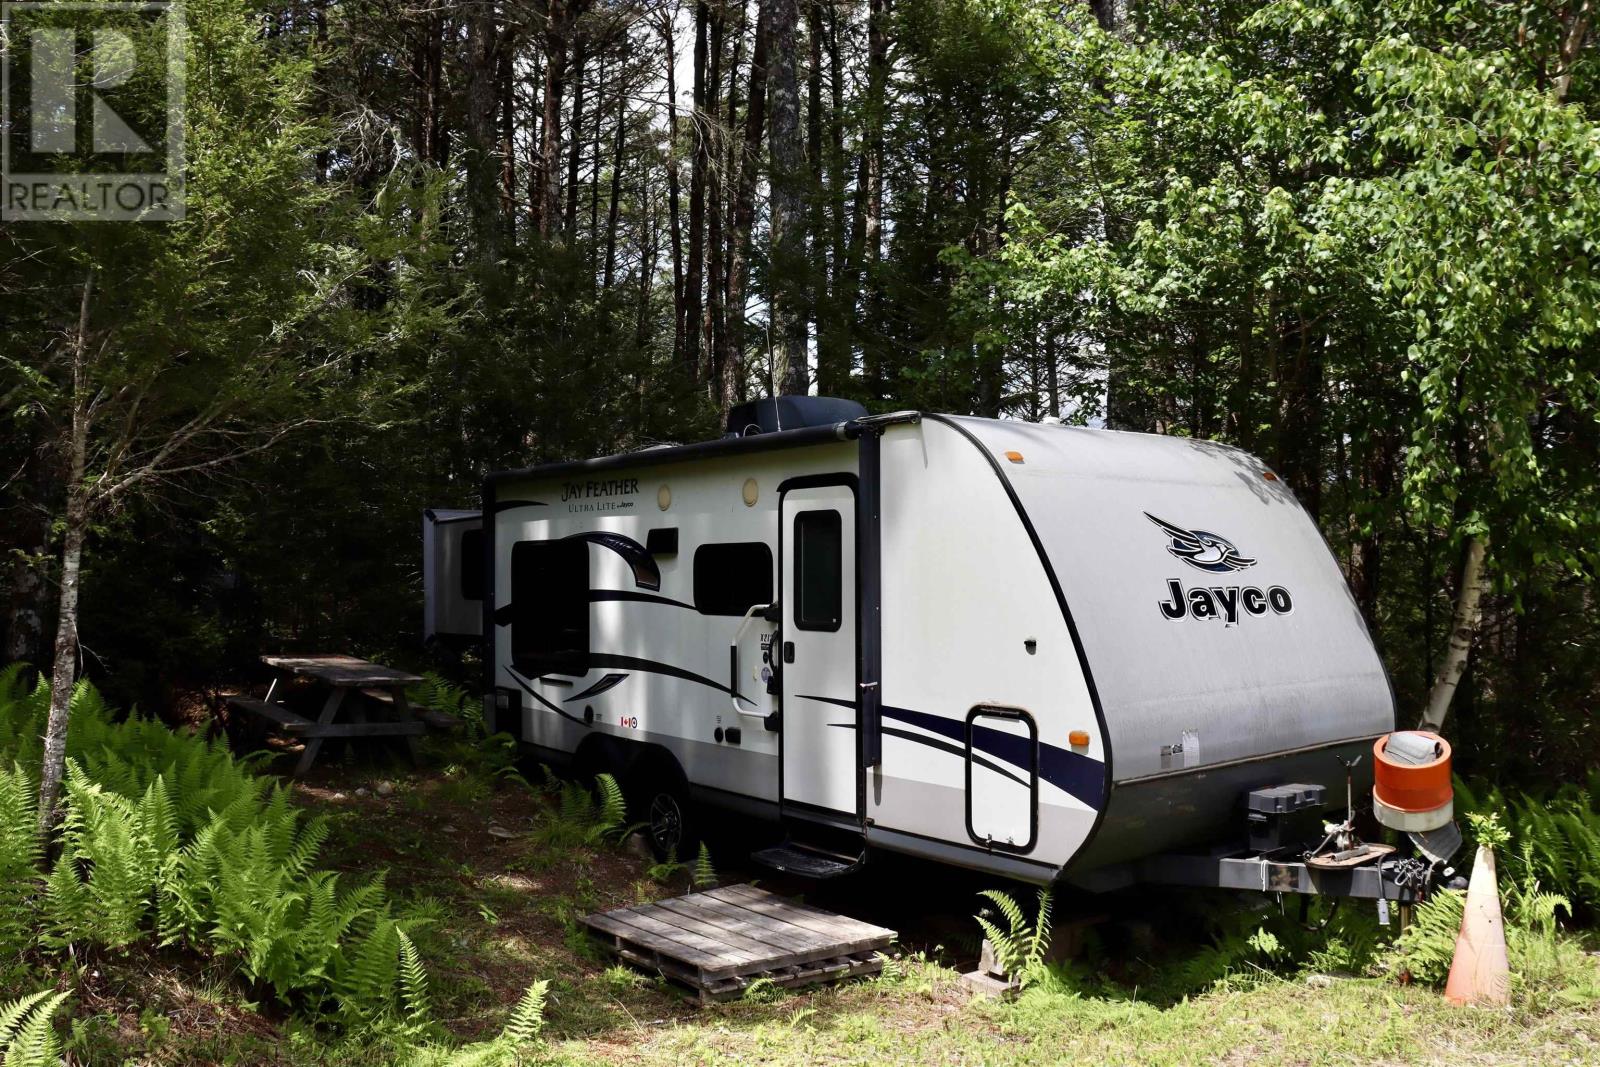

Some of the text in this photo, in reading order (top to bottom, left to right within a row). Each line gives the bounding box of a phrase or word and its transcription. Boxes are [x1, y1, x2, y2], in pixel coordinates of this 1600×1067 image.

[561, 479, 640, 502] JAY FEATHER
[568, 503, 594, 513] ULTRA
[597, 501, 616, 511] LITE
[1158, 578, 1295, 628] Jayco
